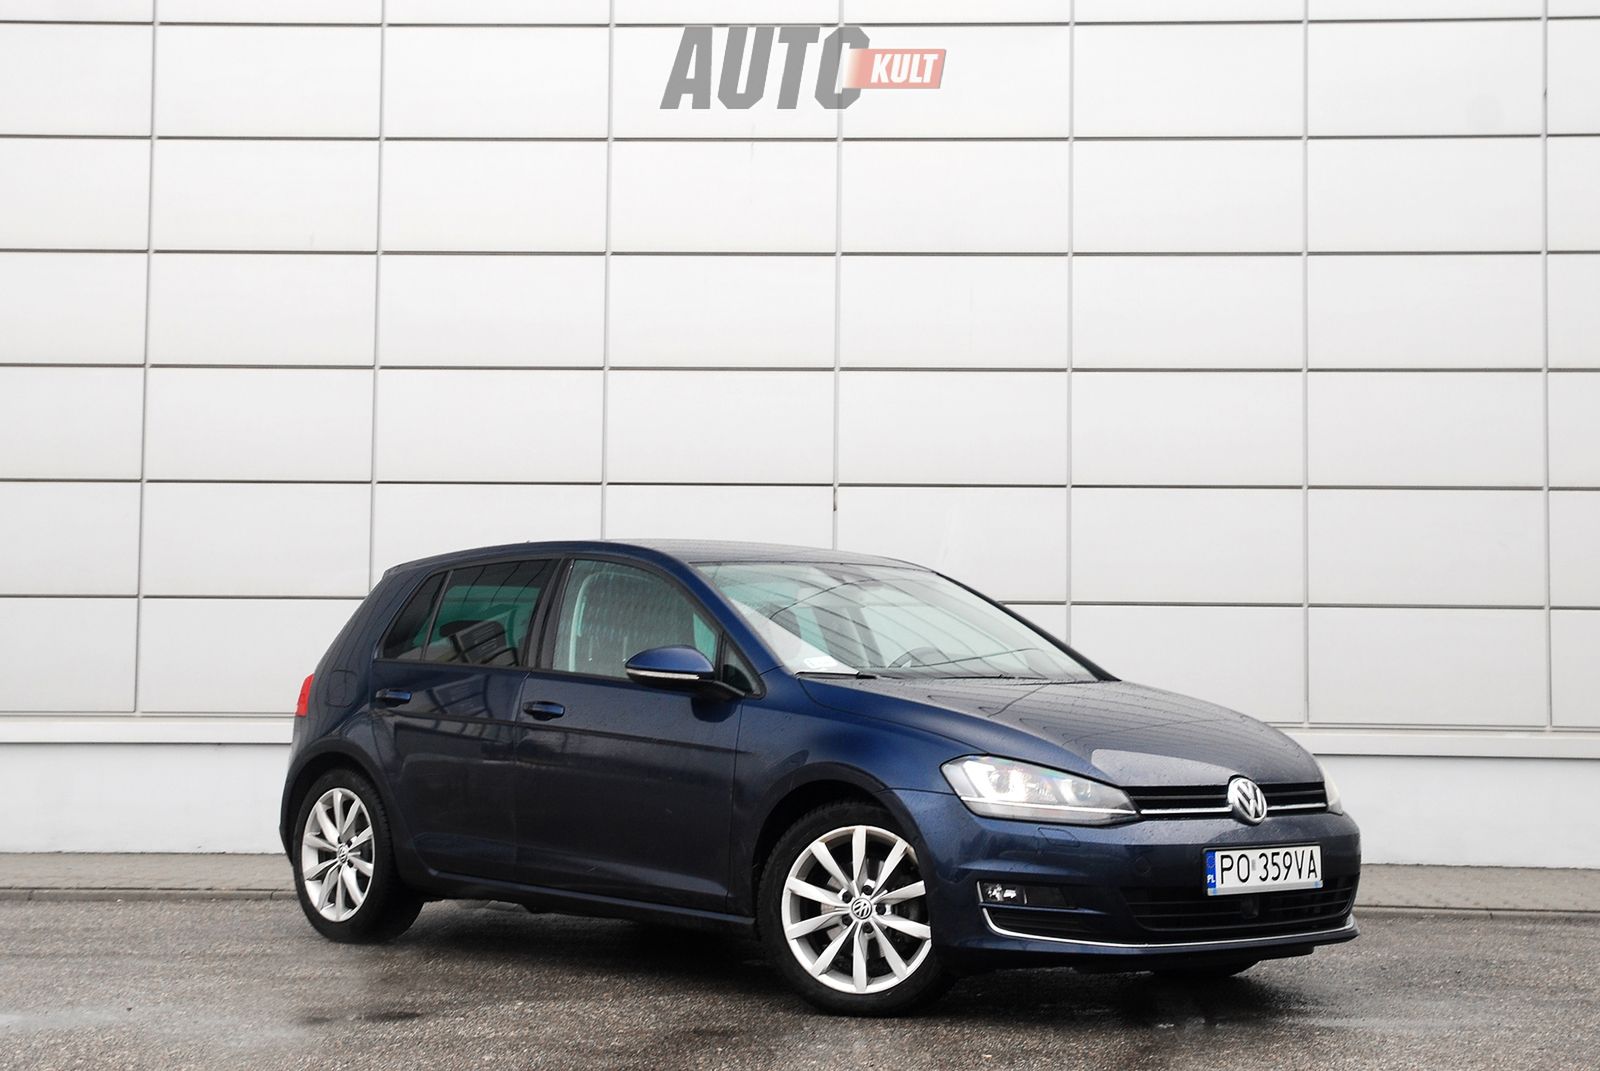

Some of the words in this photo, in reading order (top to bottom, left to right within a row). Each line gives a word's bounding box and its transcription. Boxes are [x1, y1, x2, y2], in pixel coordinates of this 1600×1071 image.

[1220, 853, 1250, 884] PO
[1258, 850, 1318, 881] 359VA
[1207, 874, 1216, 884] PL
